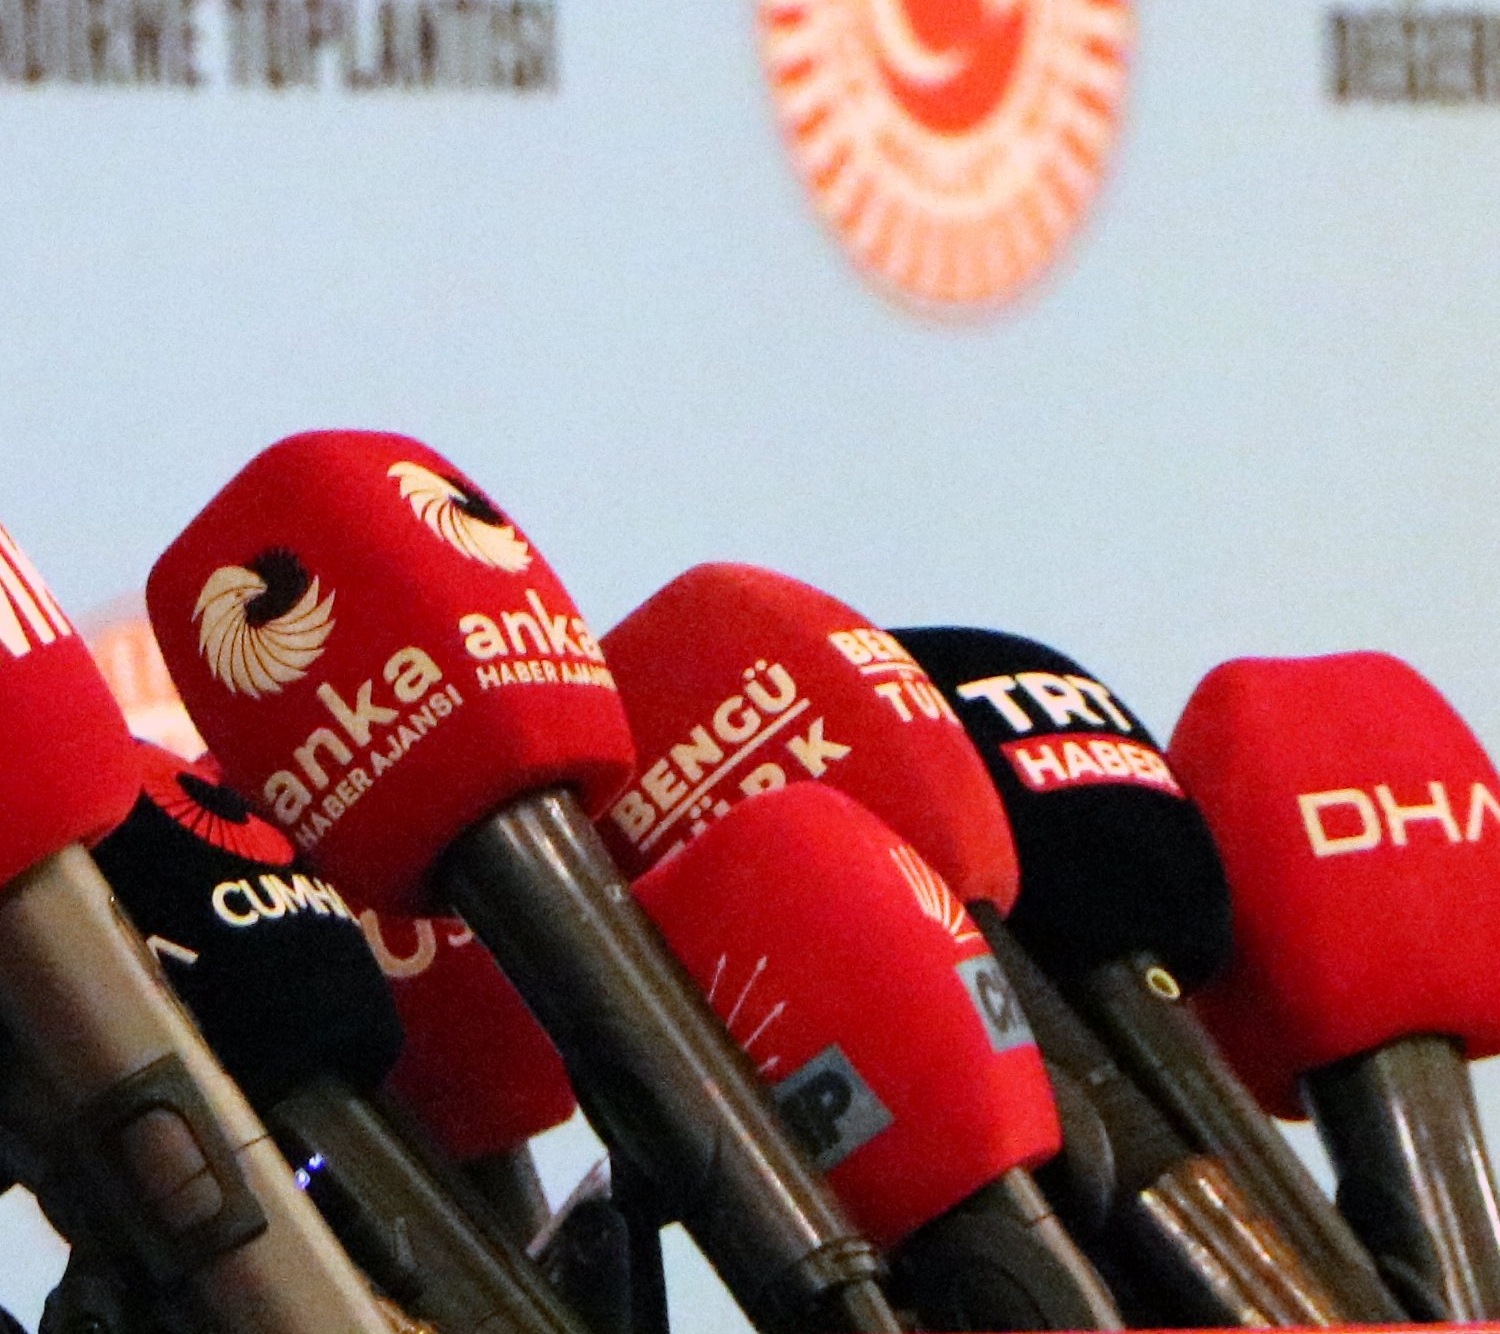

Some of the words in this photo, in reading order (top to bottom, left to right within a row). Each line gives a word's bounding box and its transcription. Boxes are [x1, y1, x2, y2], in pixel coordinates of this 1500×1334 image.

[459, 588, 607, 666] anka
[263, 646, 443, 825] anka
[956, 671, 1132, 733] TRT
[295, 768, 374, 849] HABER
[370, 683, 464, 777] AJANSI
[610, 659, 798, 843] BENGÜ
[1015, 740, 1181, 791] HABER
[212, 873, 361, 928] CUMH
